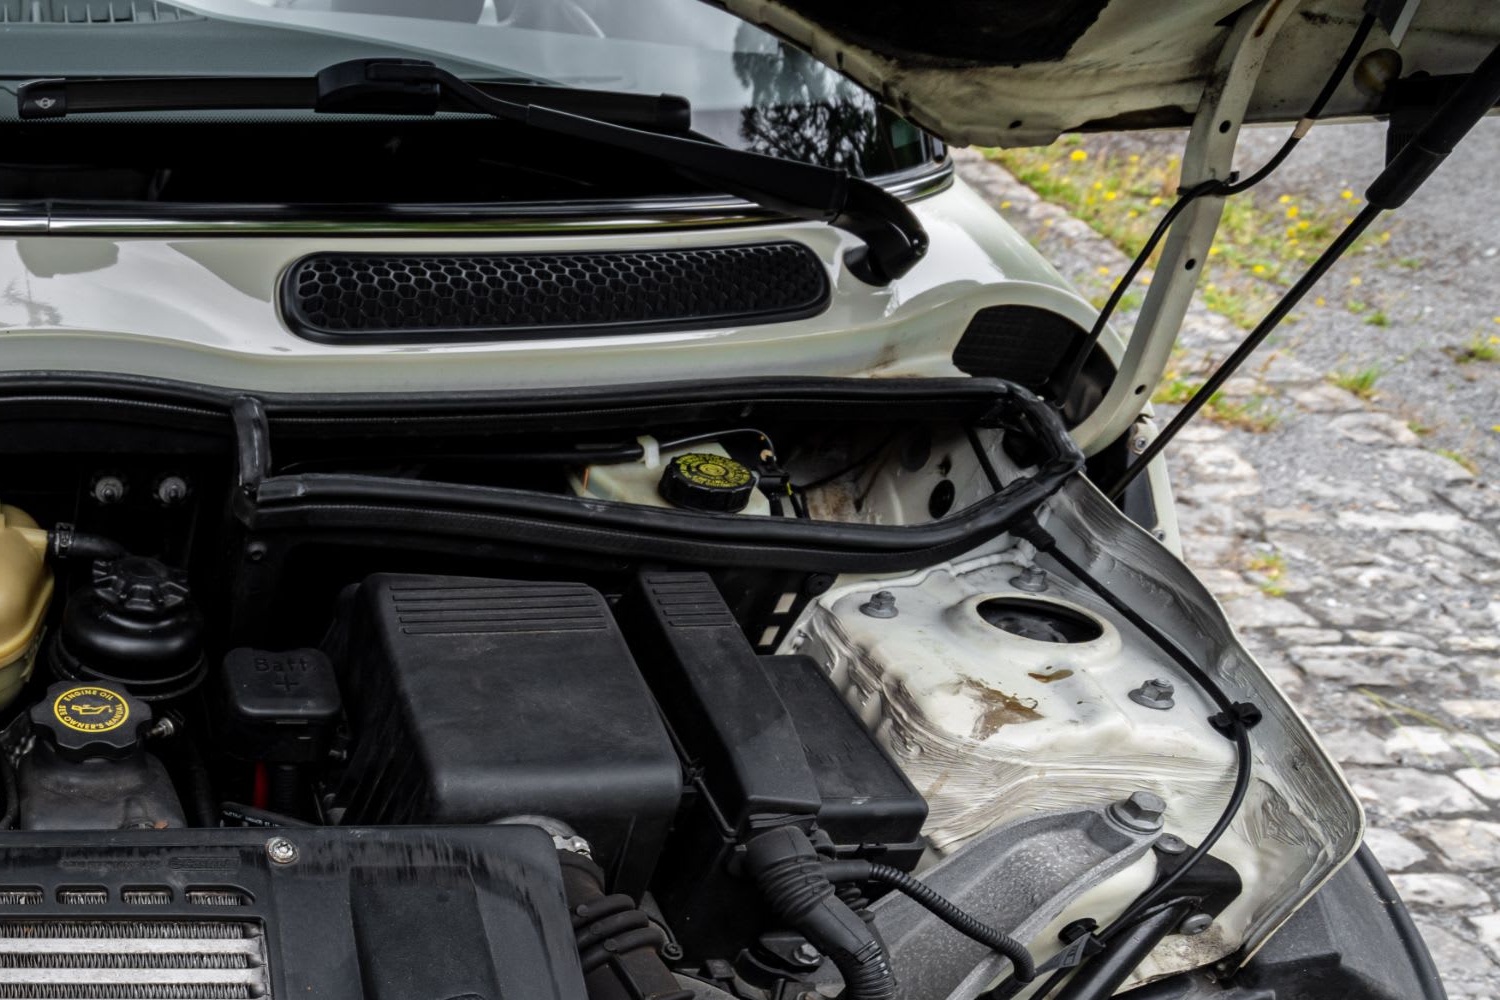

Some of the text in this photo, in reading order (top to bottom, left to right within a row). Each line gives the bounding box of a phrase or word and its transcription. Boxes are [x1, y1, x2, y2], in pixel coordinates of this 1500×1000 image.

[64, 689, 114, 702] ENGINE OIL
[64, 715, 105, 730] OWNER'S
